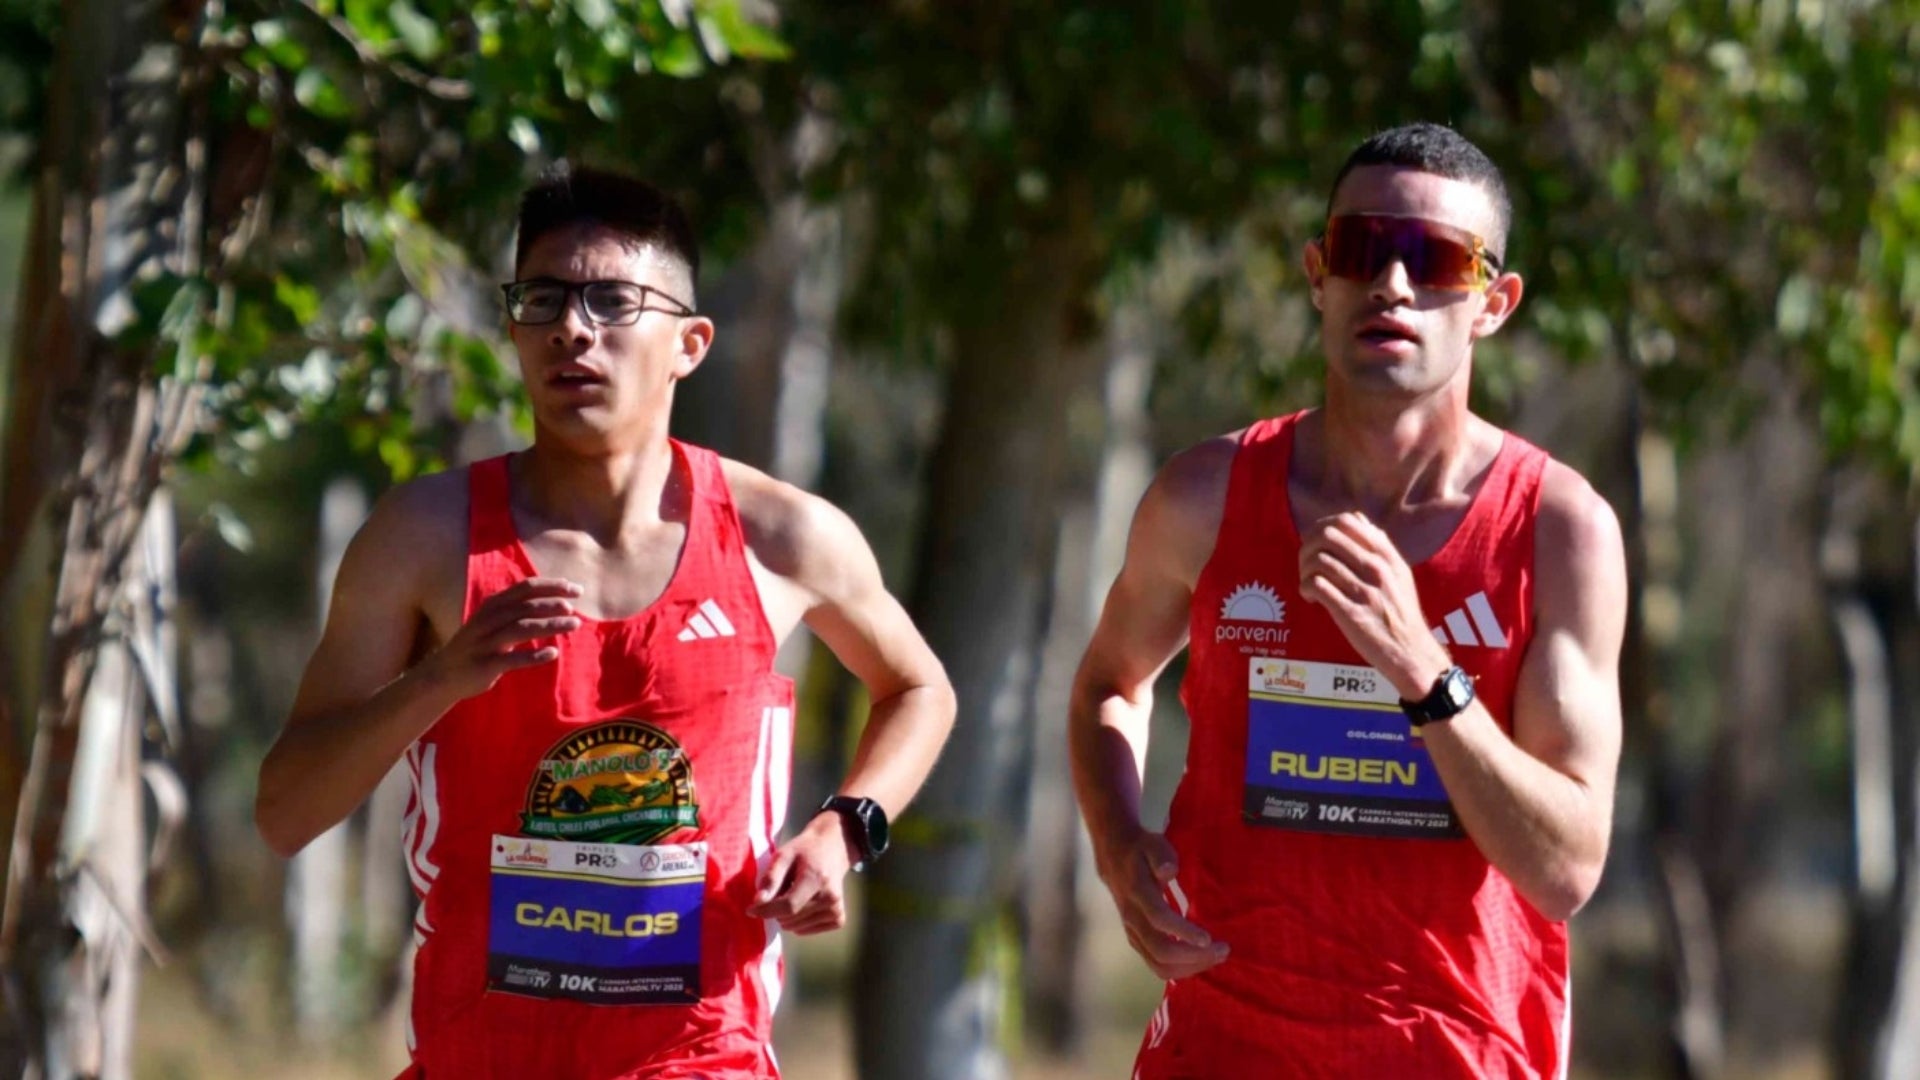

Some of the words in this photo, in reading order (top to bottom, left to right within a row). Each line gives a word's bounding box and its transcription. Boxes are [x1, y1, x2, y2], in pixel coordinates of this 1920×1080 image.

[1216, 626, 1290, 644] porvenir
[1333, 676, 1377, 693] PRO
[1346, 730, 1404, 741] COLOMBIA
[1270, 751, 1416, 785] RUBEN
[1318, 804, 1357, 823] 10K
[1359, 808, 1392, 816] CARRERA
[575, 852, 617, 868] PRO
[516, 902, 679, 938] CARLOS
[560, 974, 597, 992] 10K
